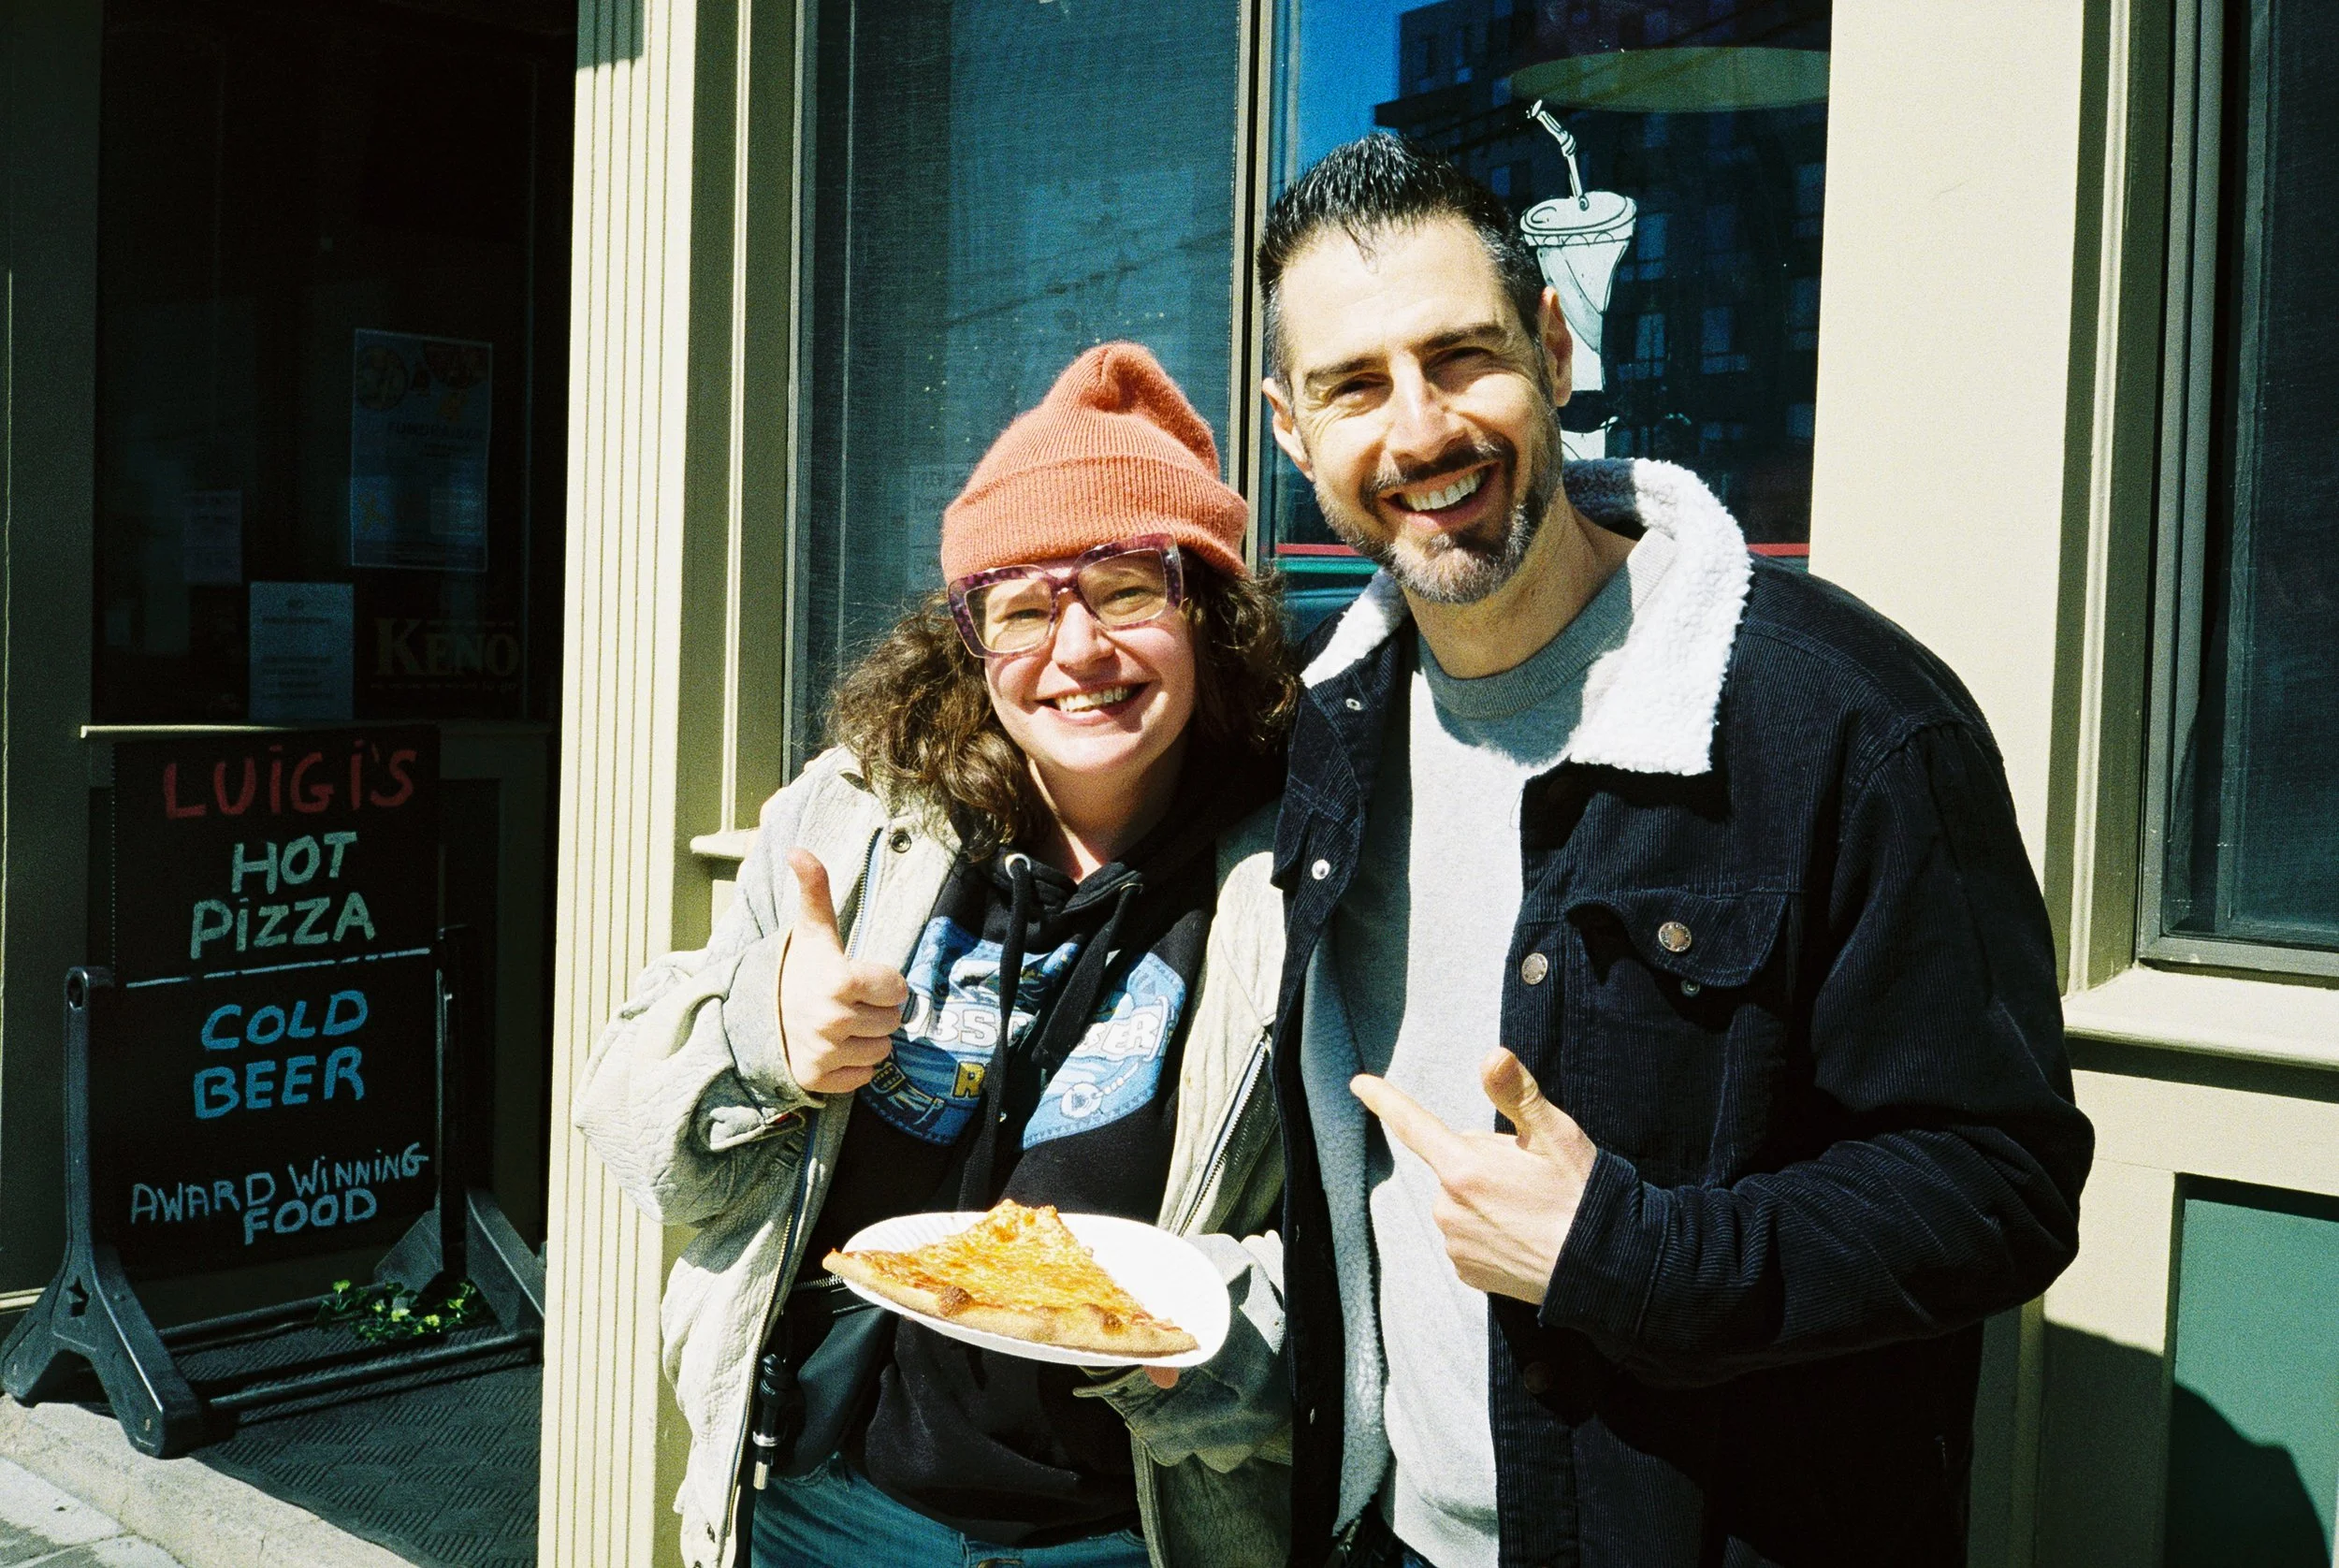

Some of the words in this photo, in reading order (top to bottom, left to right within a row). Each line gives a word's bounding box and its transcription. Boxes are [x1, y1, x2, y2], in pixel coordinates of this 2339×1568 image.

[373, 617, 520, 677] KENO
[231, 831, 358, 895] HOT
[200, 989, 370, 1051] COLD
[192, 1045, 365, 1121] BEER
[130, 1171, 278, 1225] AWARD
[242, 1186, 379, 1246] FOOD
